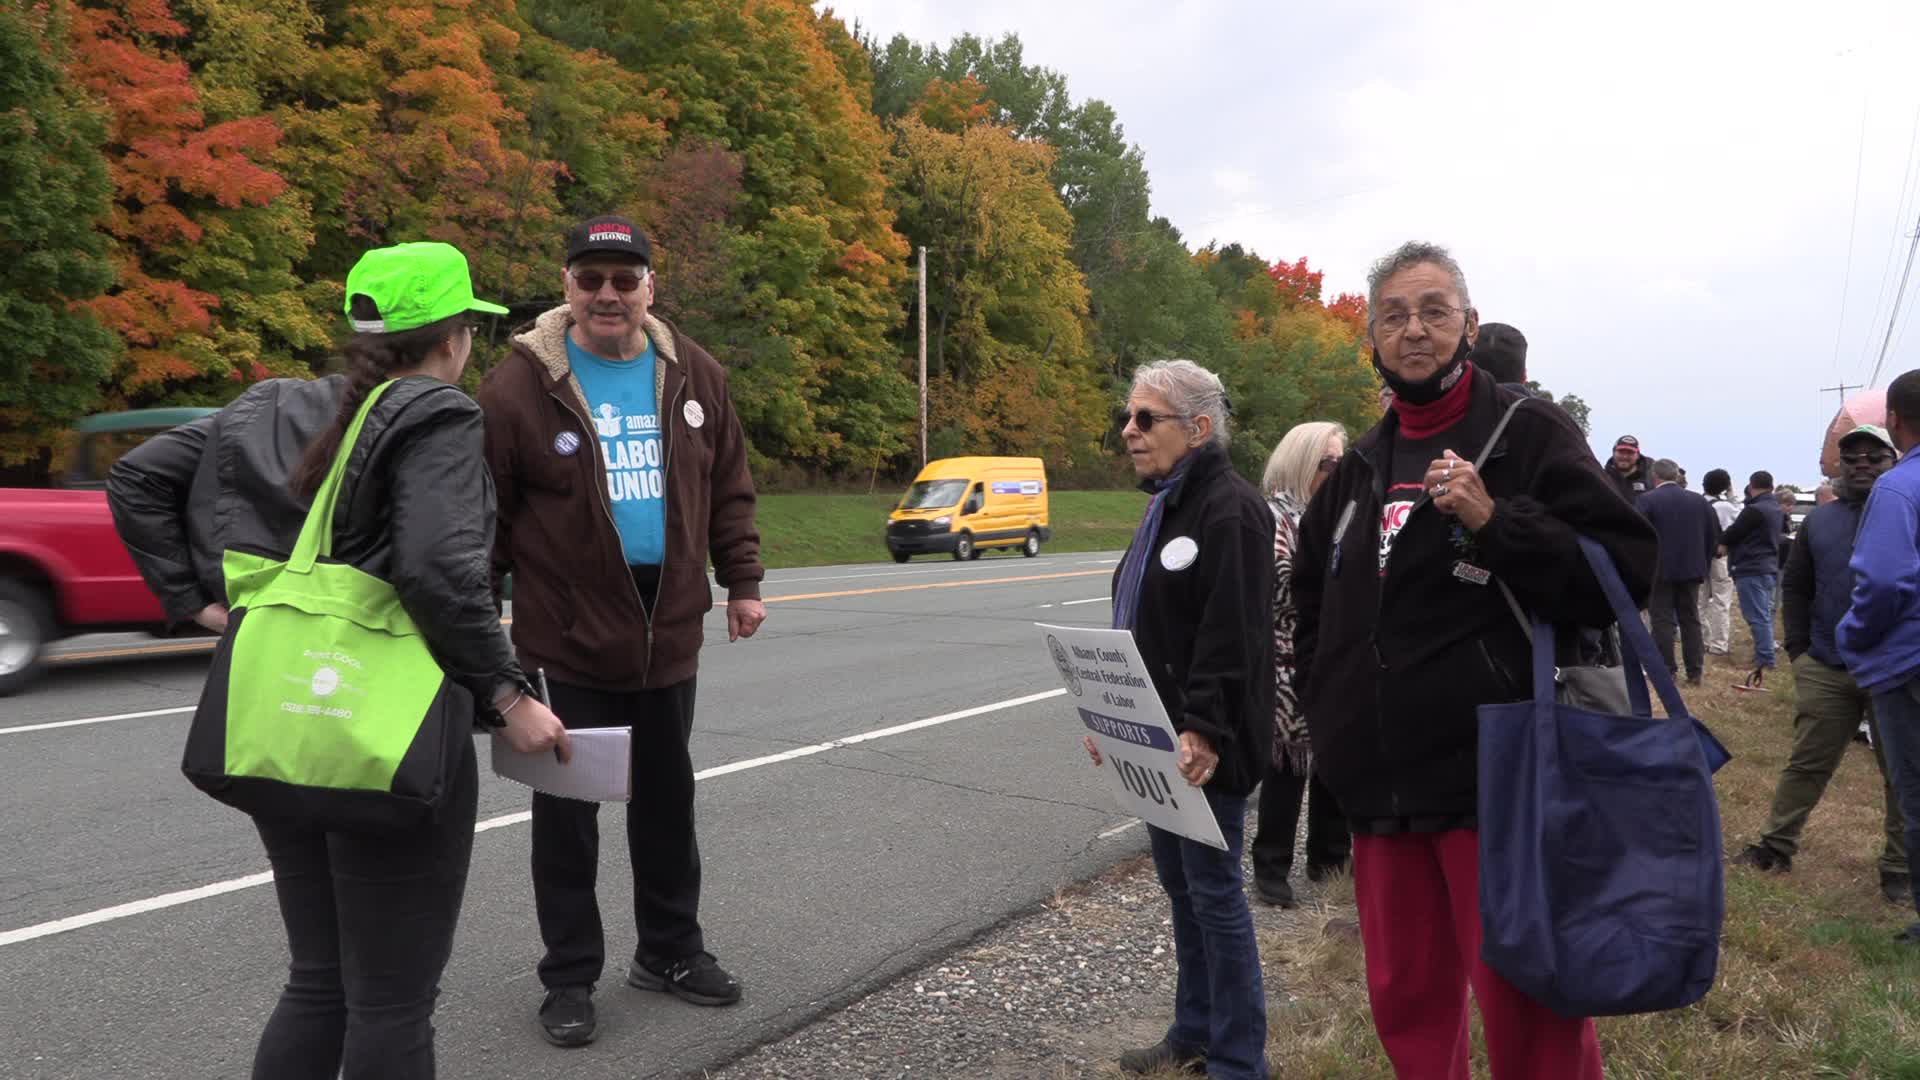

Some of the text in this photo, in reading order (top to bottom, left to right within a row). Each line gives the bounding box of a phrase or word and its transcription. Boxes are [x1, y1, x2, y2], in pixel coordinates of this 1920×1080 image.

[589, 232, 631, 242] STRONG!
[625, 414, 658, 430] amaz
[607, 469, 665, 502] UNIO
[1097, 647, 1129, 668] County
[1102, 669, 1148, 689] Federation
[1102, 692, 1136, 710] of Labor
[1090, 714, 1151, 745] SUPPORTS
[1109, 754, 1179, 810] YOU!
